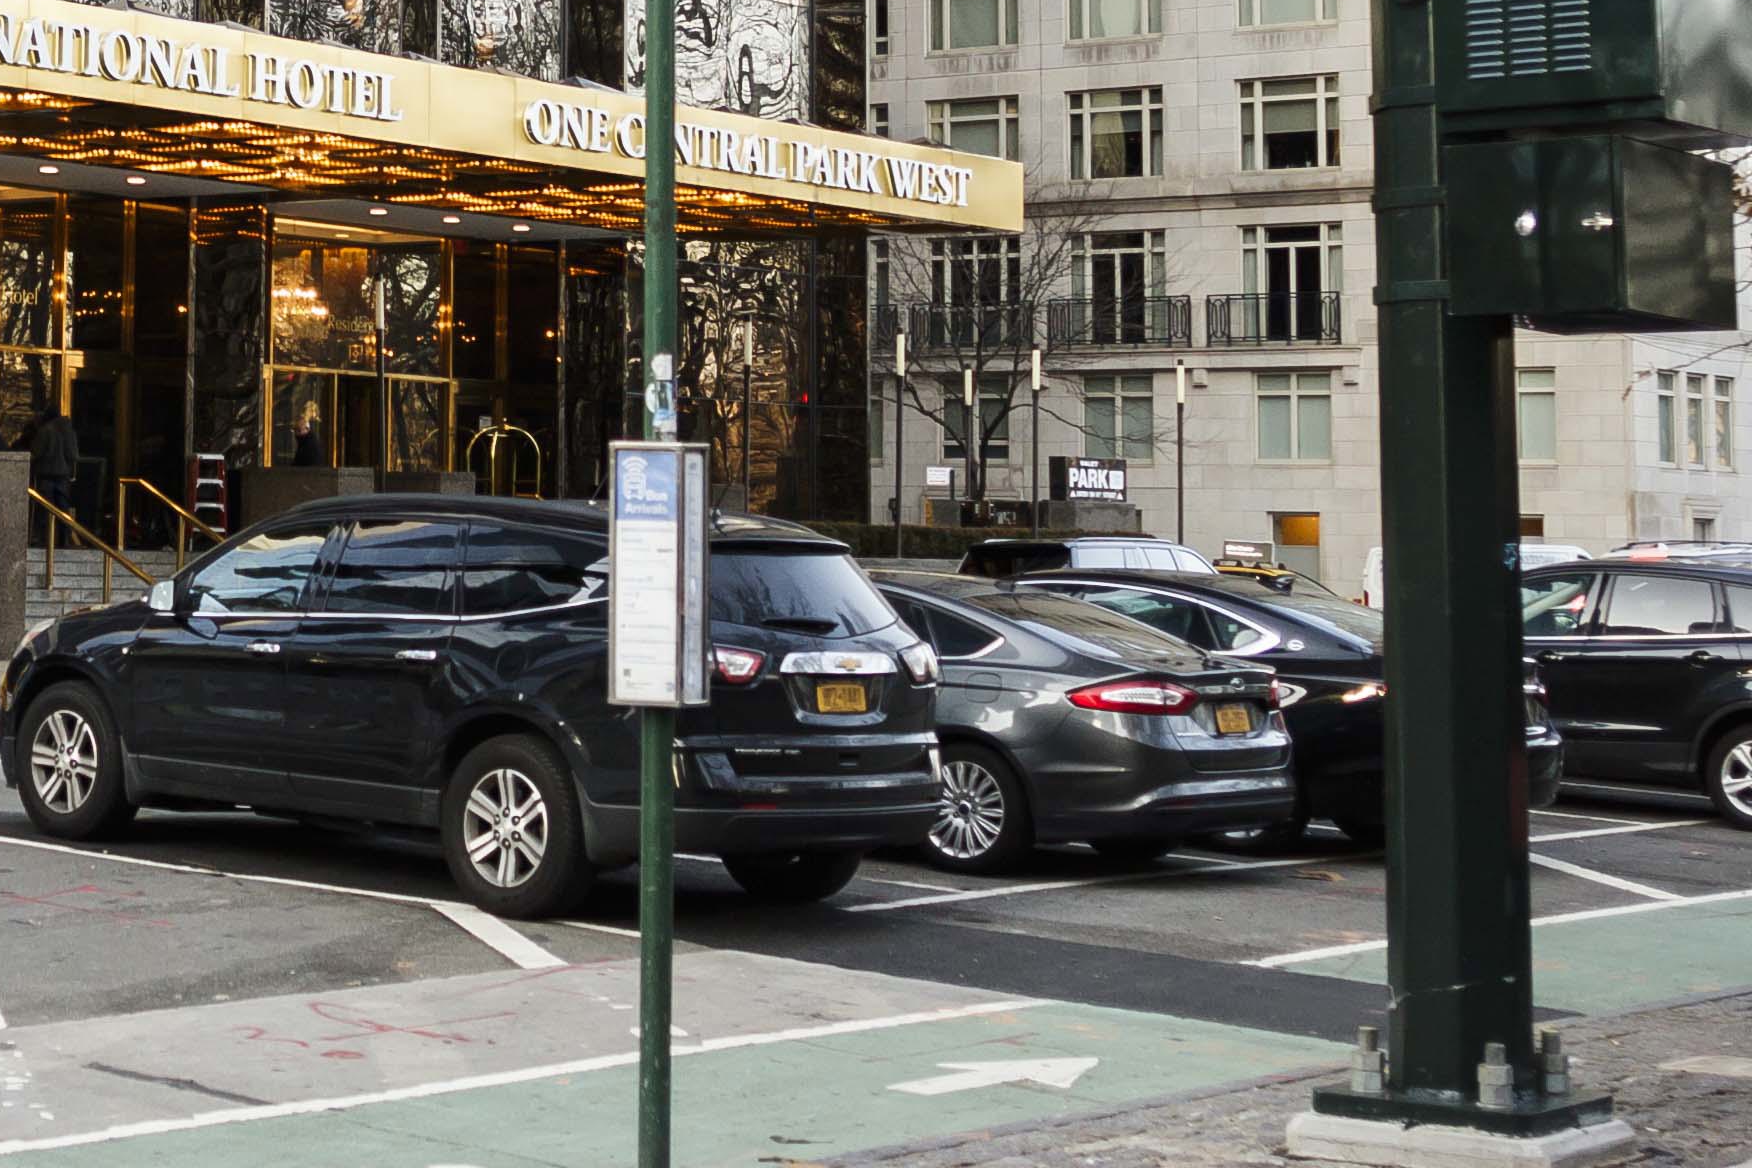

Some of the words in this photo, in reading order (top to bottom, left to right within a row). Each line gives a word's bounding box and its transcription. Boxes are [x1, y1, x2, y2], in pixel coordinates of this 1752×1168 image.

[248, 54, 403, 122] HOTEL
[524, 98, 611, 152] ONE
[614, 113, 787, 180] CNTRAL
[789, 140, 882, 194] PARK
[884, 156, 974, 208] WEST
[2, 286, 39, 306] Hotel
[1068, 467, 1109, 490] PARK
